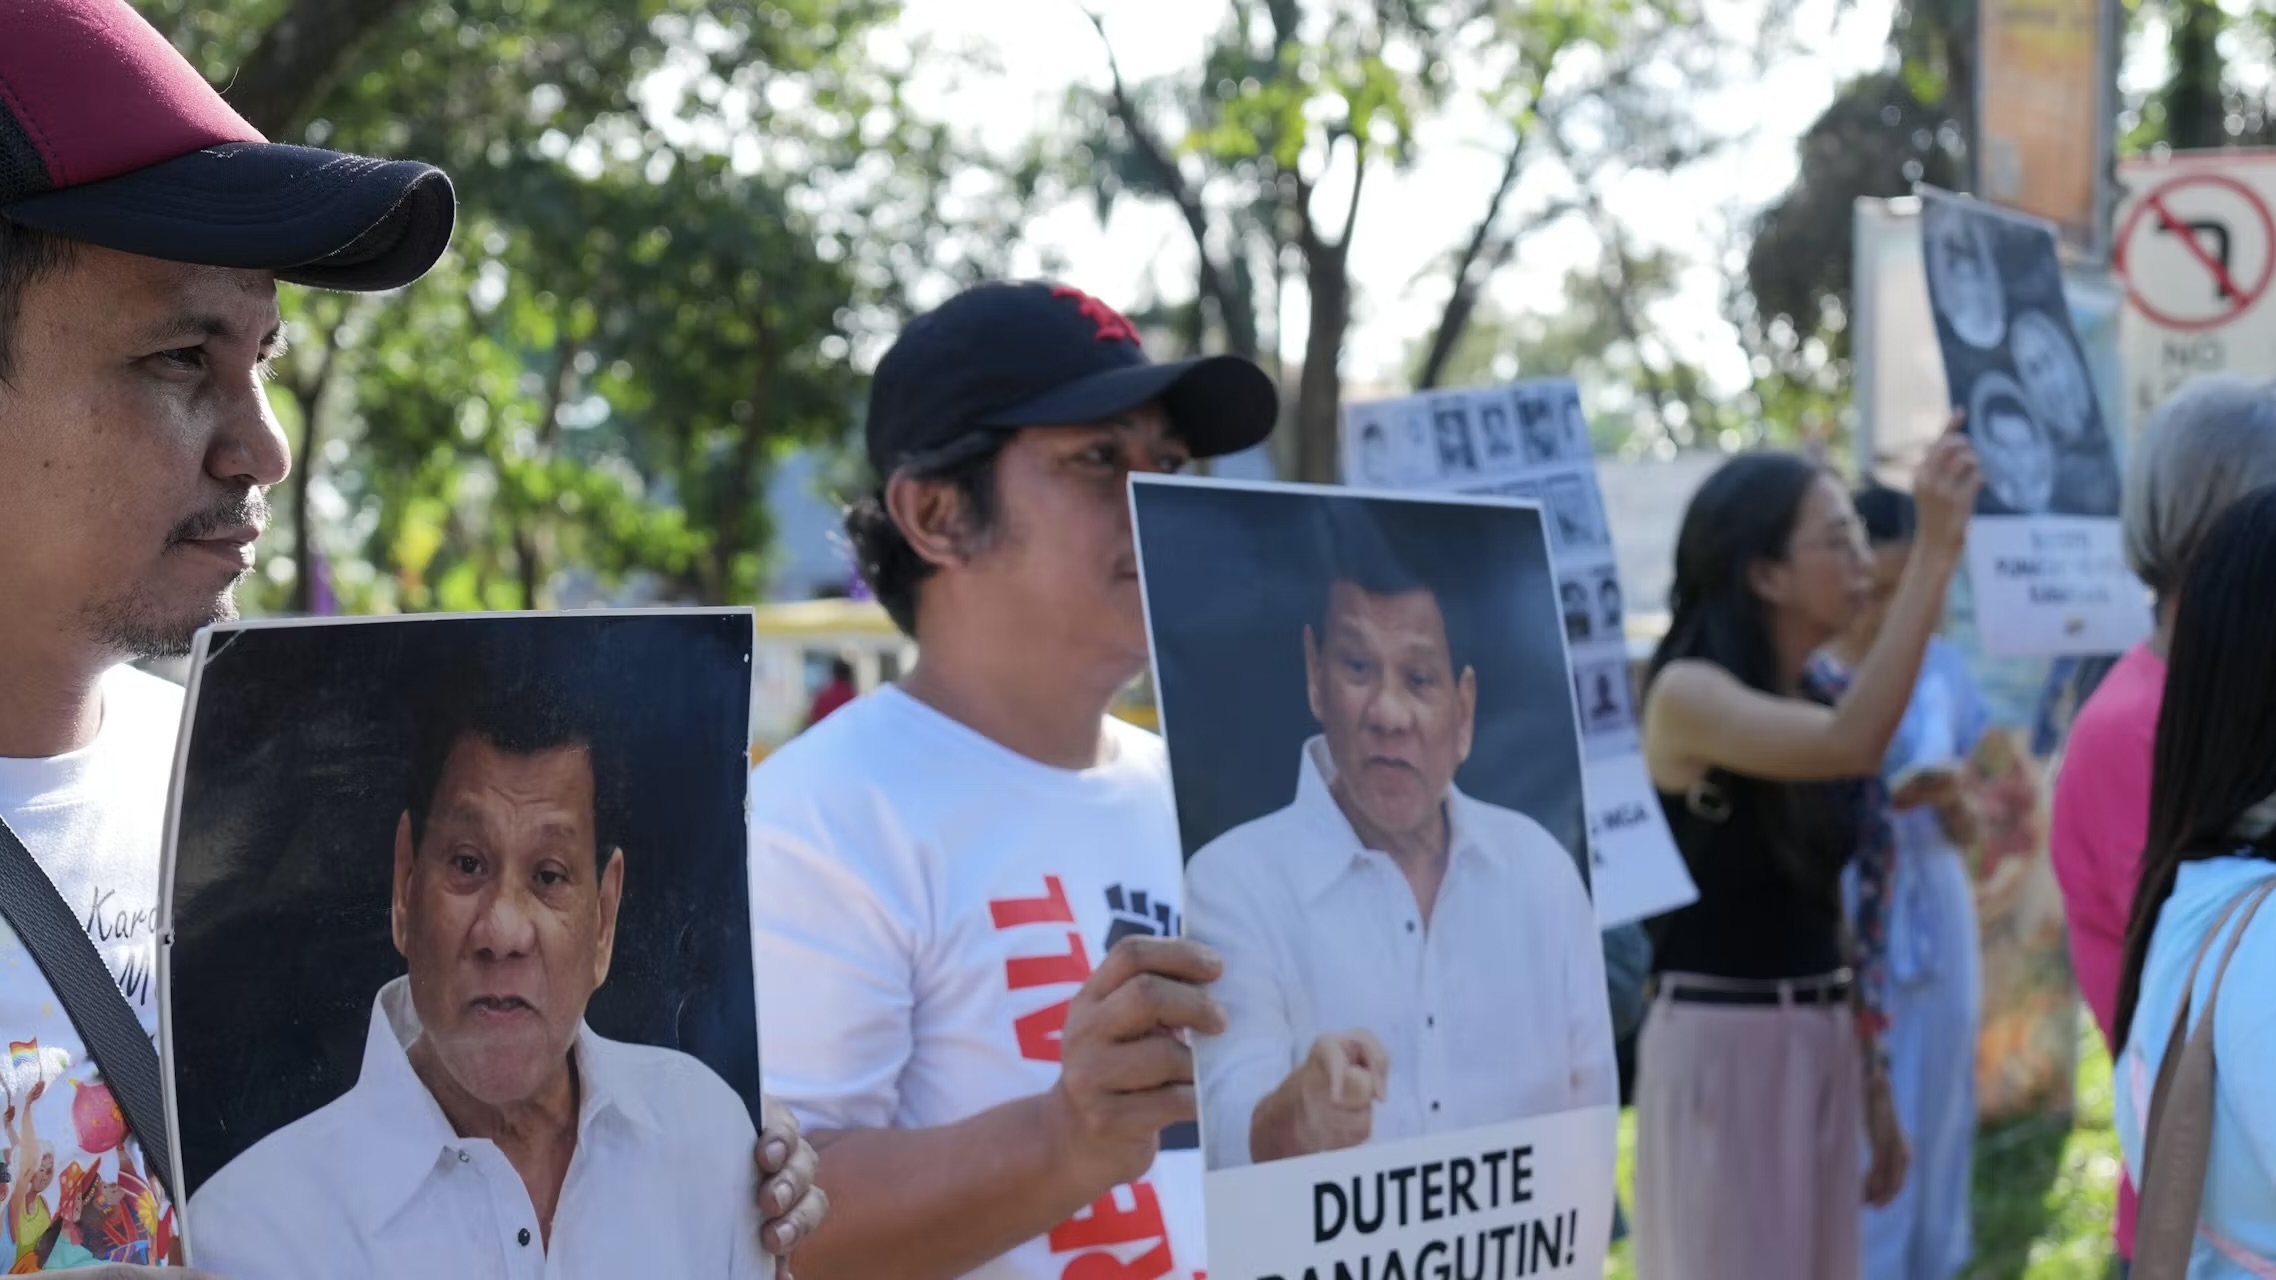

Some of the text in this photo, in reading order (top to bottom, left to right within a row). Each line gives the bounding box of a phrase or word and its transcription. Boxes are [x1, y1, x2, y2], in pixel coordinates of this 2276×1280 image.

[2162, 338, 2227, 370] NO
[1313, 1145, 1533, 1243] DUTERTE
[1257, 1209, 1577, 1280] AGUTIN!
